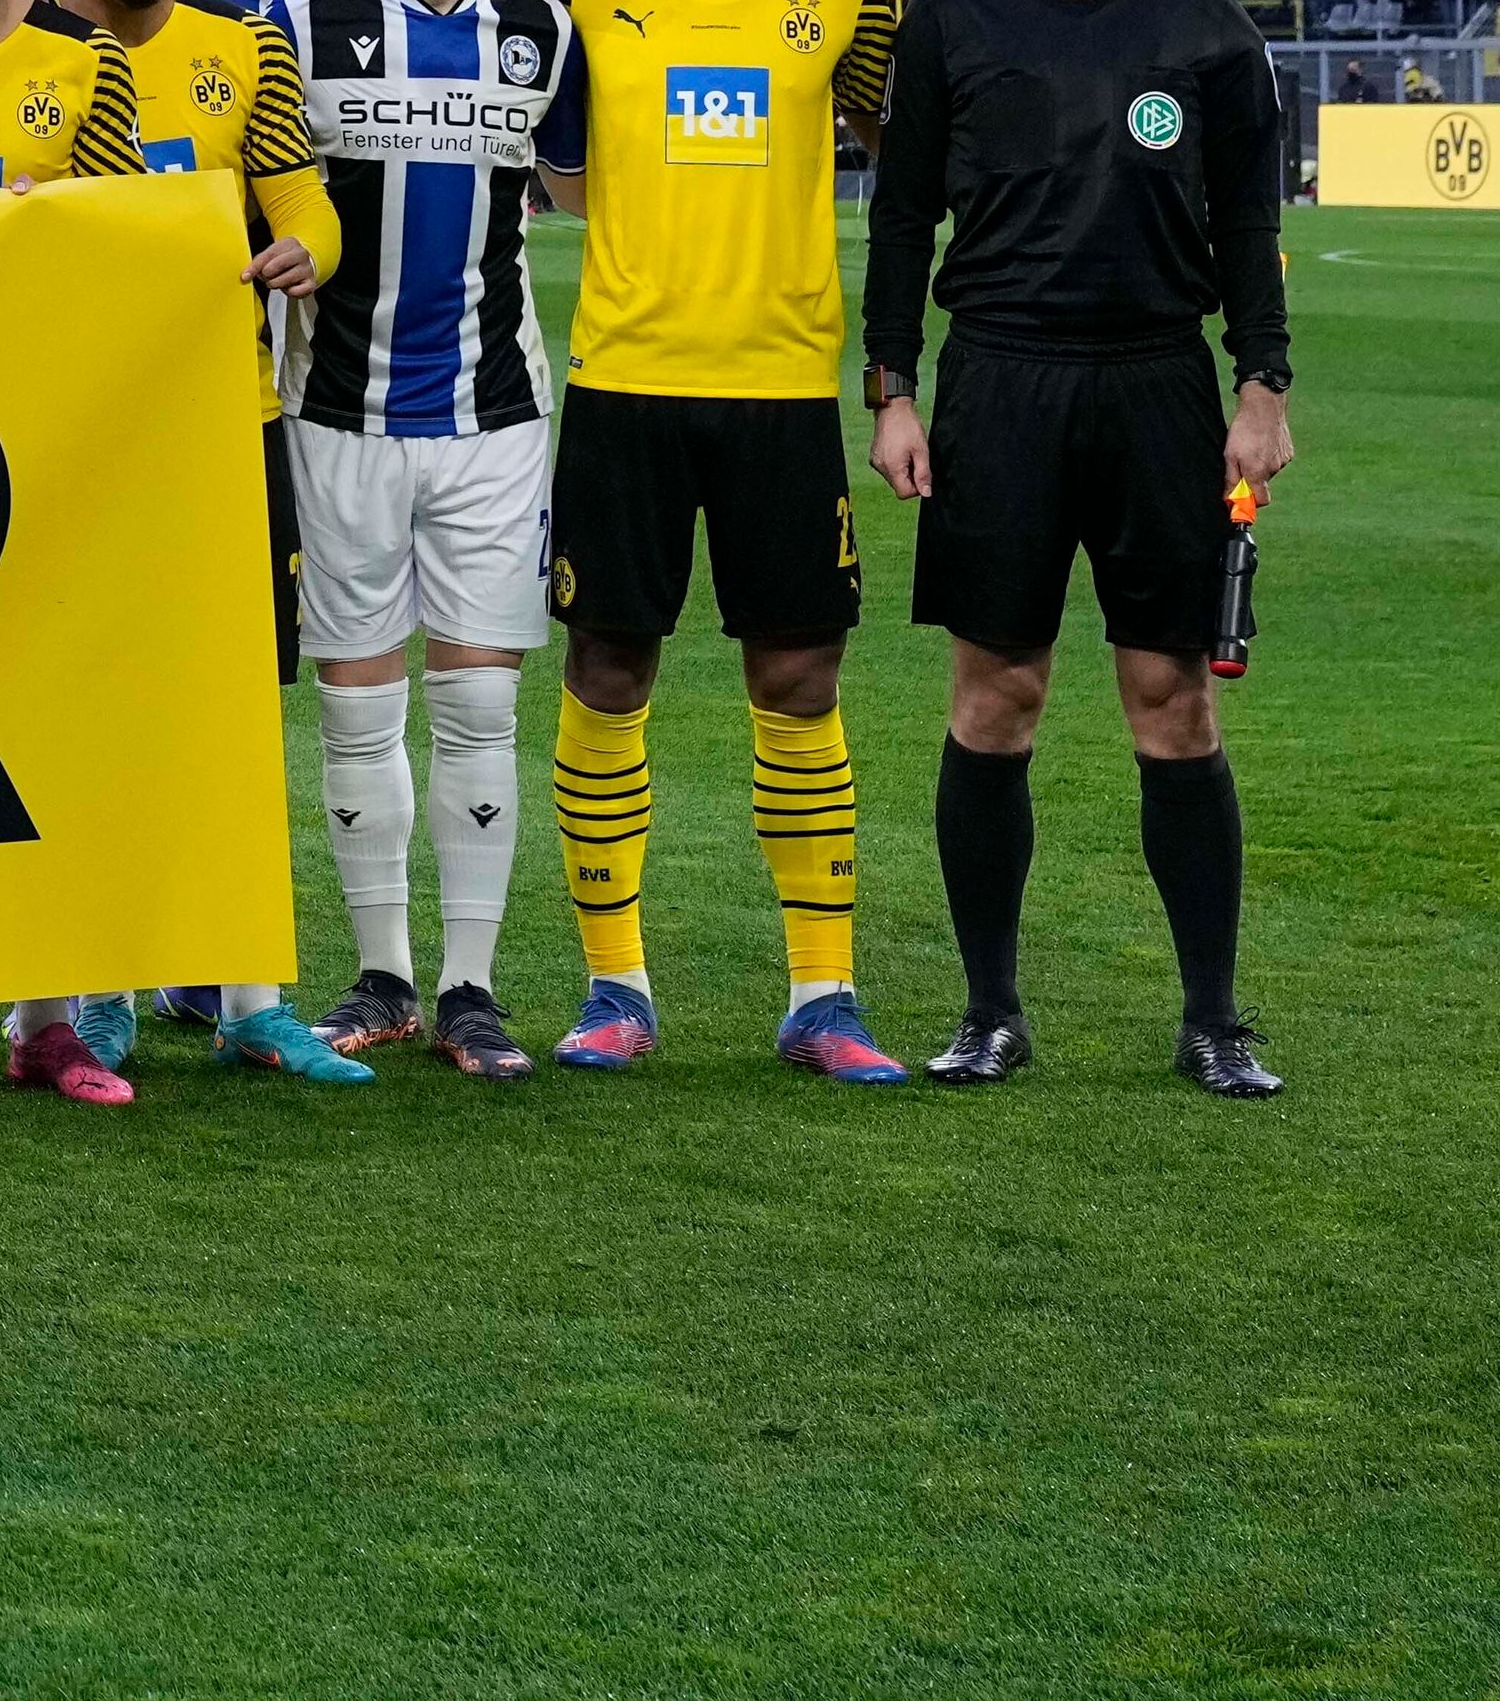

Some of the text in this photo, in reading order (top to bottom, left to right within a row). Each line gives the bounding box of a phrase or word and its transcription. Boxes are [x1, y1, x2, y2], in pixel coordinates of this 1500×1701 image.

[787, 13, 821, 40] BVB
[796, 39, 810, 50] 09
[196, 74, 231, 102] BVB
[23, 96, 60, 124] BVB
[209, 101, 223, 112] 09
[338, 92, 528, 134] SCHÜCO
[676, 90, 756, 139] 1&1
[34, 123, 49, 135] 09
[343, 130, 423, 150] Fenster
[431, 134, 472, 153] und
[1435, 121, 1483, 173] BVB
[579, 866, 611, 882] BVB
[830, 859, 854, 877] BVB
